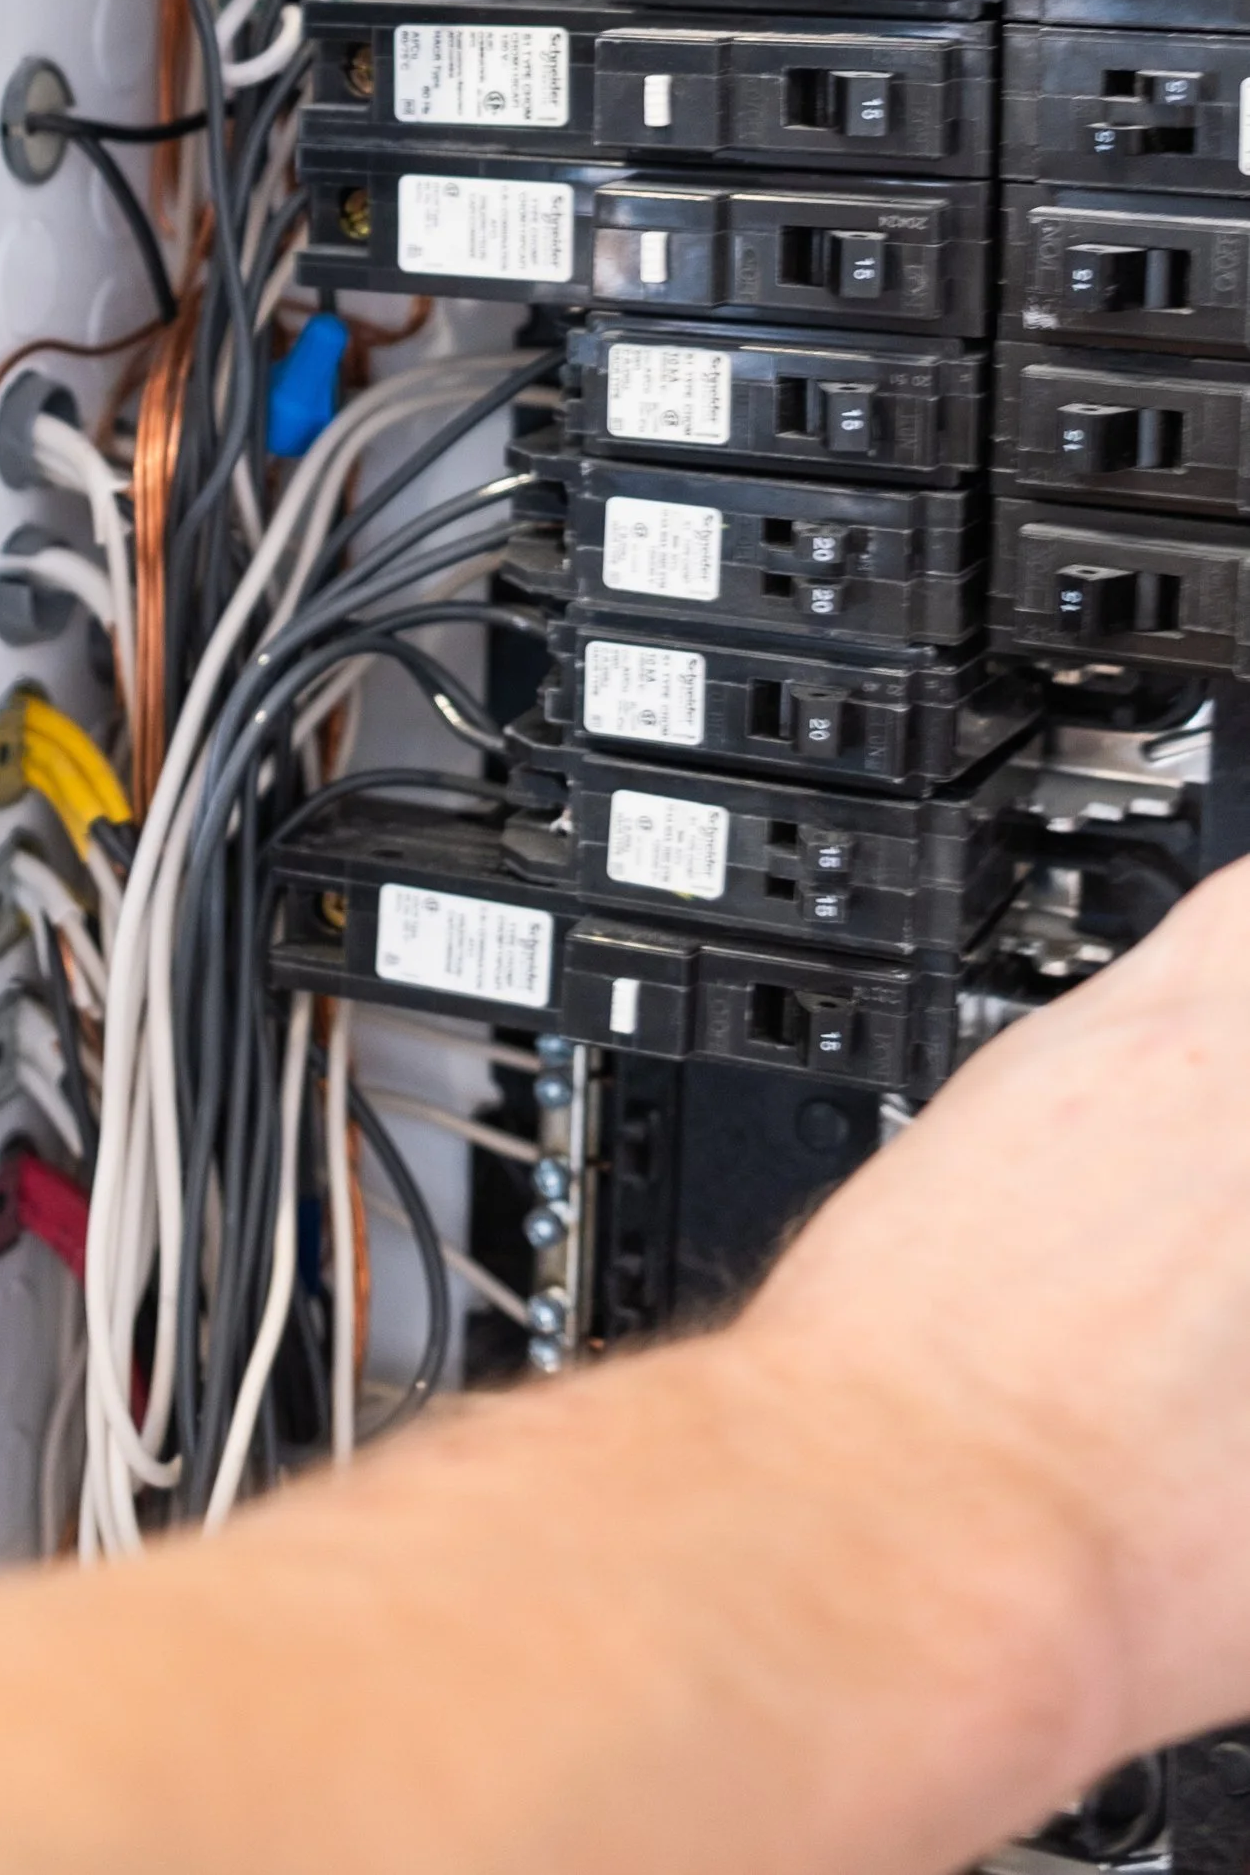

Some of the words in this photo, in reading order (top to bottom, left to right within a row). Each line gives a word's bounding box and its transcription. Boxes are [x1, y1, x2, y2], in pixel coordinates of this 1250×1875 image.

[550, 33, 563, 107] Schneider
[861, 98, 884, 119] 15
[853, 257, 875, 280] 15
[841, 409, 864, 431] 15
[812, 537, 836, 562] 20
[811, 588, 834, 614] 20
[809, 718, 831, 741] 20
[818, 847, 842, 868] 15
[815, 896, 839, 917] 15
